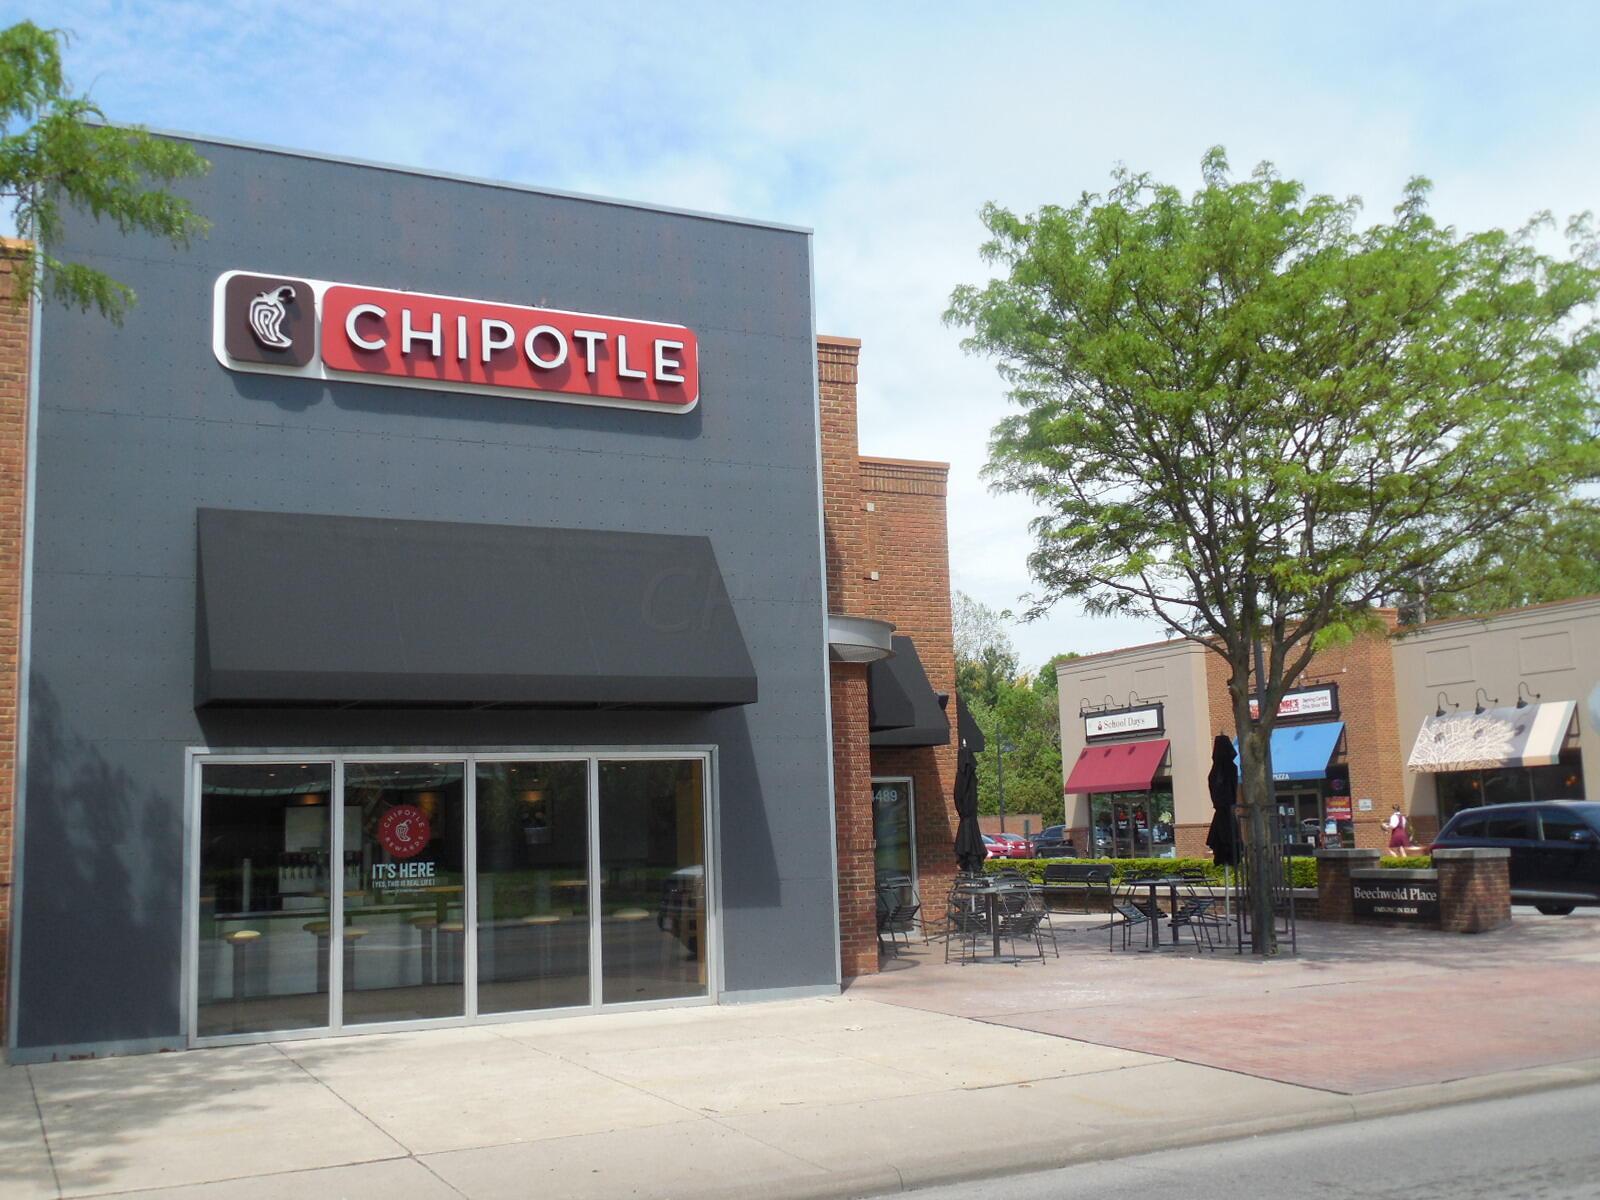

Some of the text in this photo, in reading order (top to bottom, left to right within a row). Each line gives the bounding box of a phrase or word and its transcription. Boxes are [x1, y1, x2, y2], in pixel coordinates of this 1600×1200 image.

[345, 303, 685, 384] CHIPOTLE
[1103, 716, 1145, 729] School Days
[384, 809, 425, 828] CHIPOTLE
[372, 862, 436, 880] IT'S HERE
[1353, 886, 1437, 901] Beechwold Place
